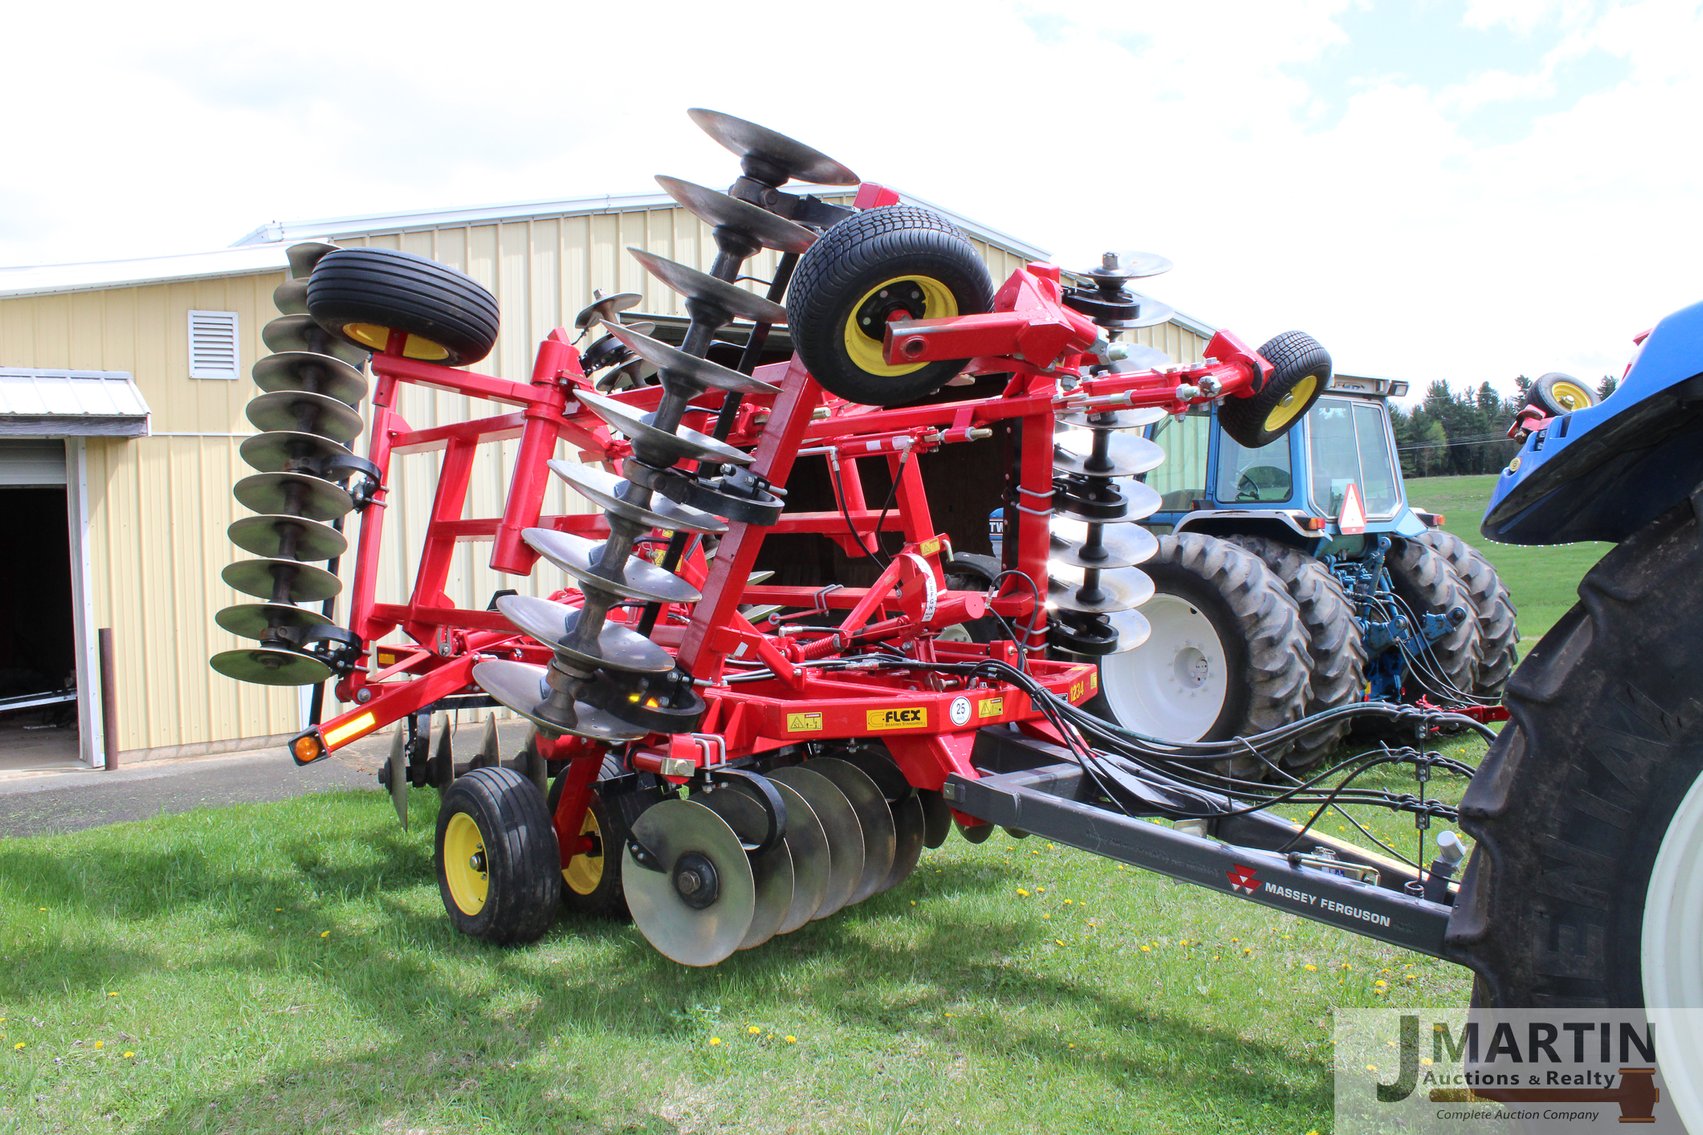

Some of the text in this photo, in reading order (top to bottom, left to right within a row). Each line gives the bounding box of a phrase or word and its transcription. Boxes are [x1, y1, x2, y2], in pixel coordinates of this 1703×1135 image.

[1070, 680, 1085, 702] 1234
[956, 703, 966, 715] 25
[1264, 882, 1391, 928] MASSEY FERGUSON
